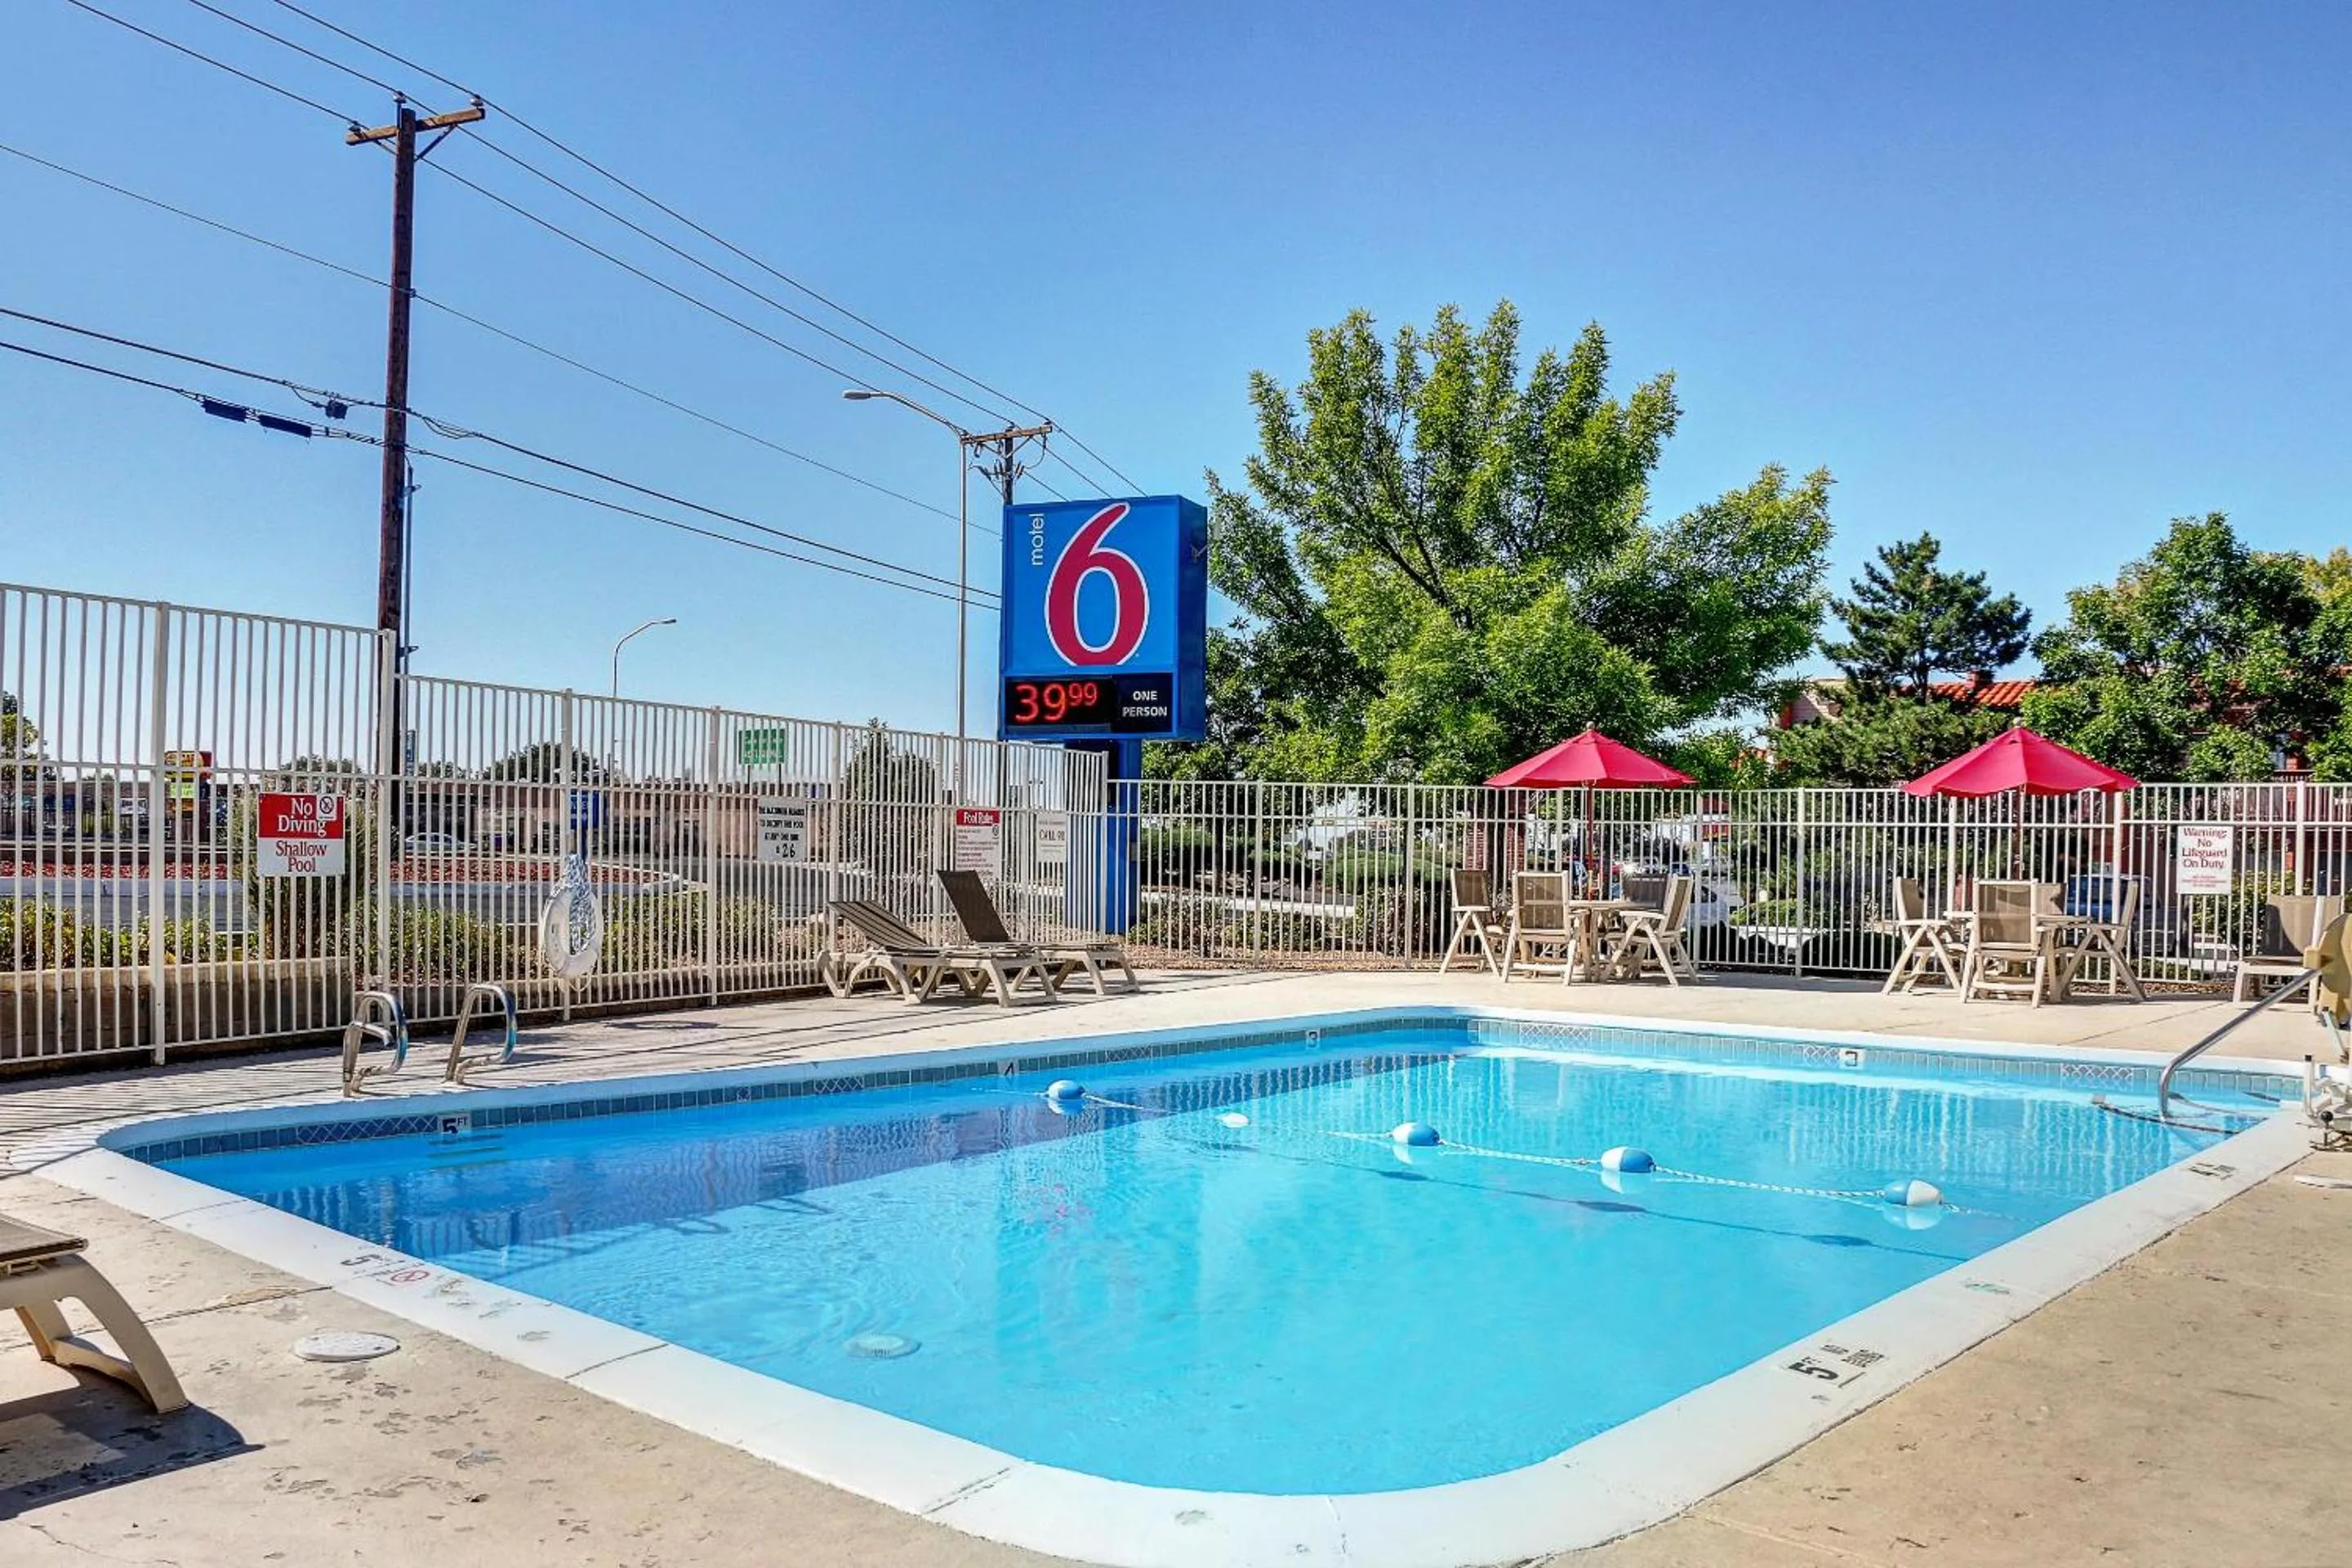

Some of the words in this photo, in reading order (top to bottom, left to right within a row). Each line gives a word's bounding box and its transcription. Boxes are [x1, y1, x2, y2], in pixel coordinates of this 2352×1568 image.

[1029, 514, 1045, 565] motel
[1045, 501, 1150, 666] 6
[1133, 691, 1158, 702] ONE
[1122, 706, 1167, 717] PERSON
[292, 798, 313, 816] No
[964, 812, 978, 824] Pool
[278, 814, 327, 838] Diving
[1040, 829, 1055, 841] CALL
[275, 840, 327, 857] Shallow
[782, 843, 795, 858] 26
[2198, 839, 2212, 848] No
[2182, 848, 2227, 858] Lifeguard
[287, 858, 316, 873] Pool
[2183, 858, 2198, 867] On
[2201, 858, 2225, 869] Duty
[442, 1118, 458, 1134] 5
[1788, 1361, 1838, 1380] 5
